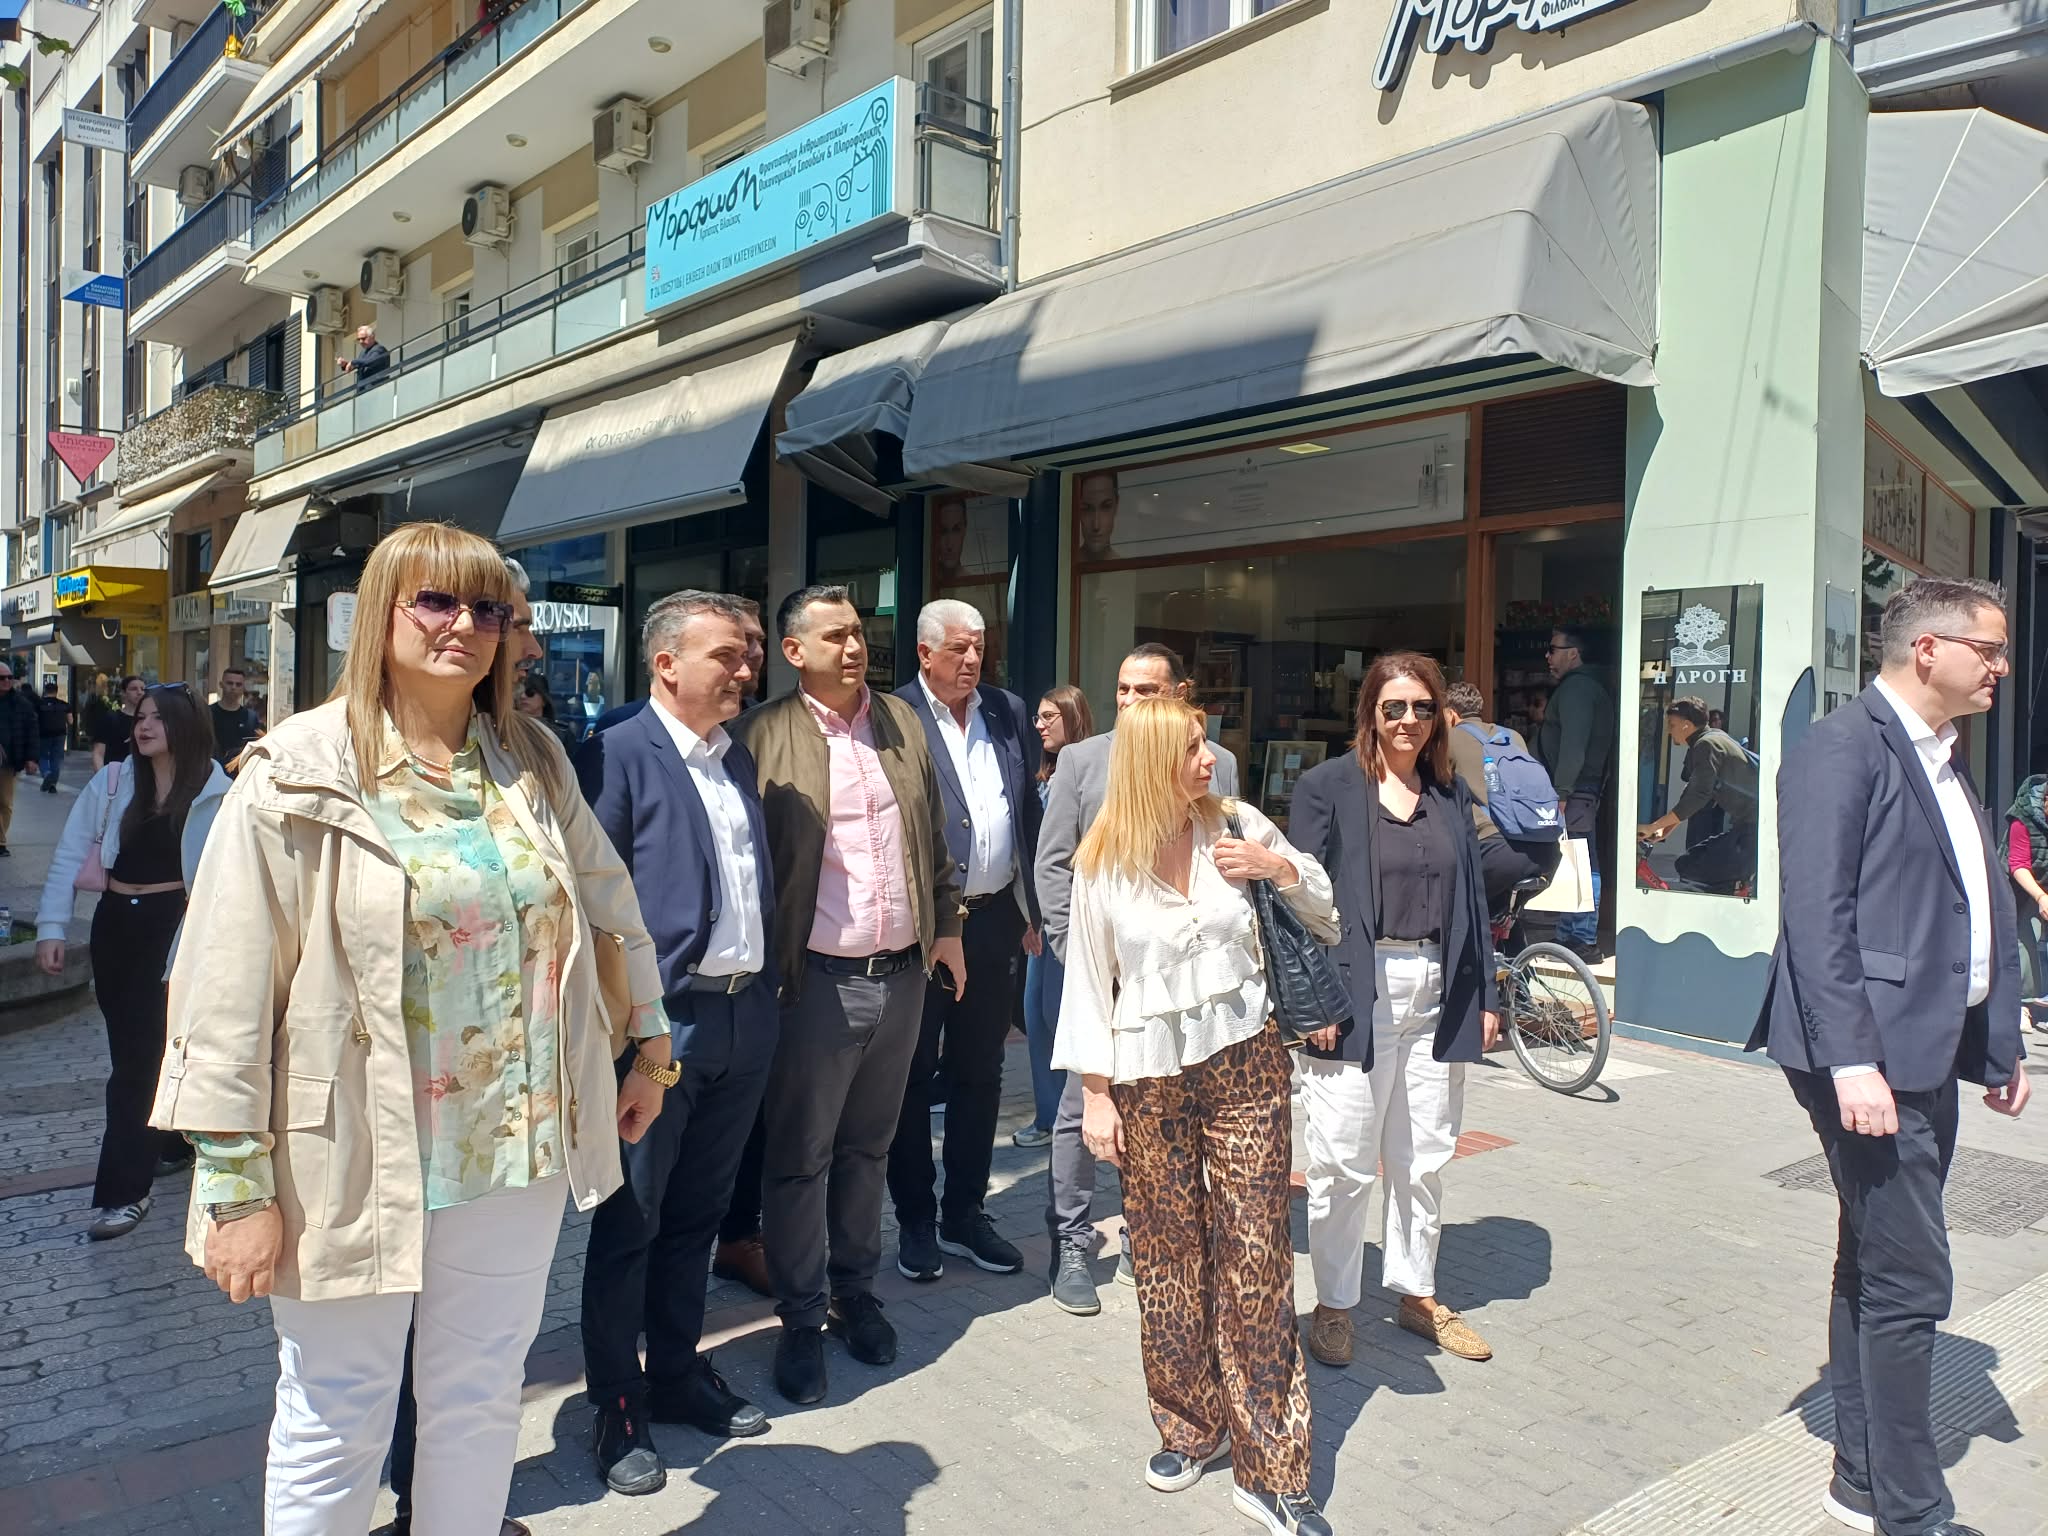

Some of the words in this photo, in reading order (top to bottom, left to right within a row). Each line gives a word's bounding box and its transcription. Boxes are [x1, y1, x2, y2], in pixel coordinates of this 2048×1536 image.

[57, 434, 107, 449] Unicorn
[1653, 672, 1668, 685] Η
[1675, 669, 1748, 684] ΔΡΟΓΗ
